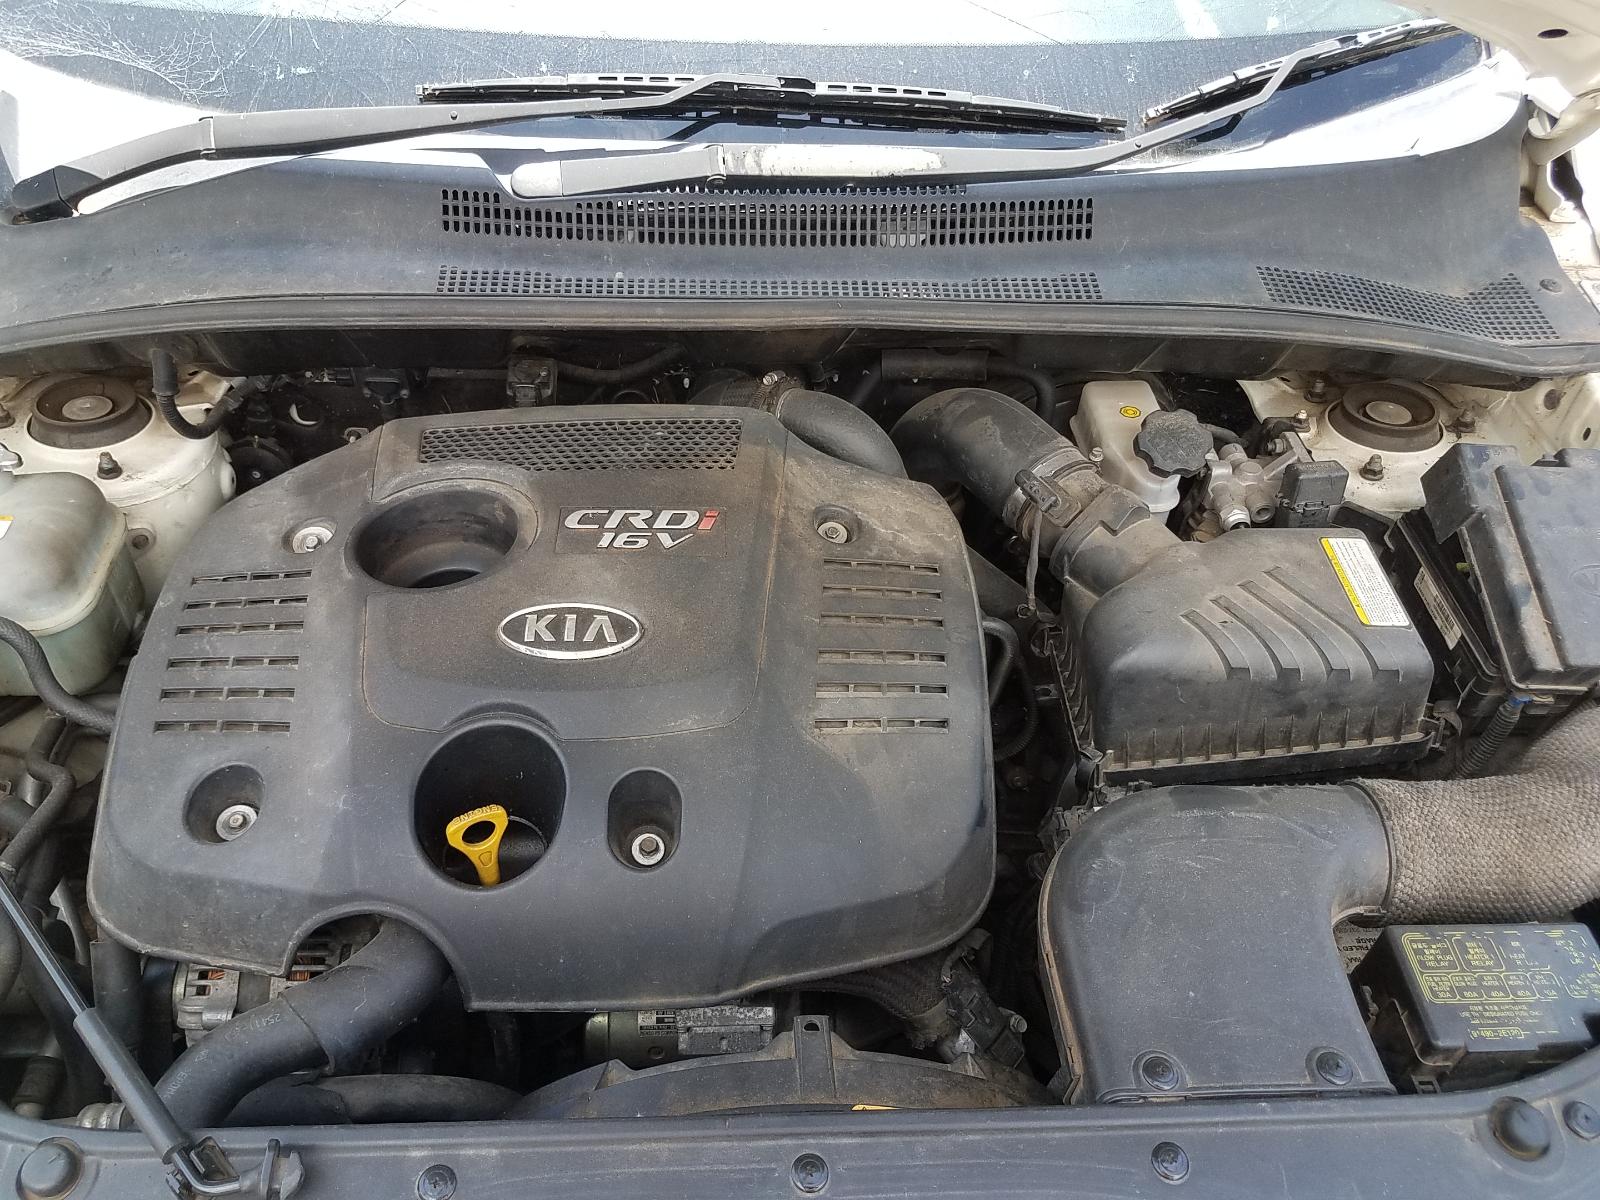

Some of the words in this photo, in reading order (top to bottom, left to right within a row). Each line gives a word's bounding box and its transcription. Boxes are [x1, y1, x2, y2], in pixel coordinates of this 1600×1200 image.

[564, 509, 720, 530] CRDi
[596, 532, 694, 549] 16V
[524, 613, 618, 643] KIA
[451, 804, 499, 826] ENGINE
